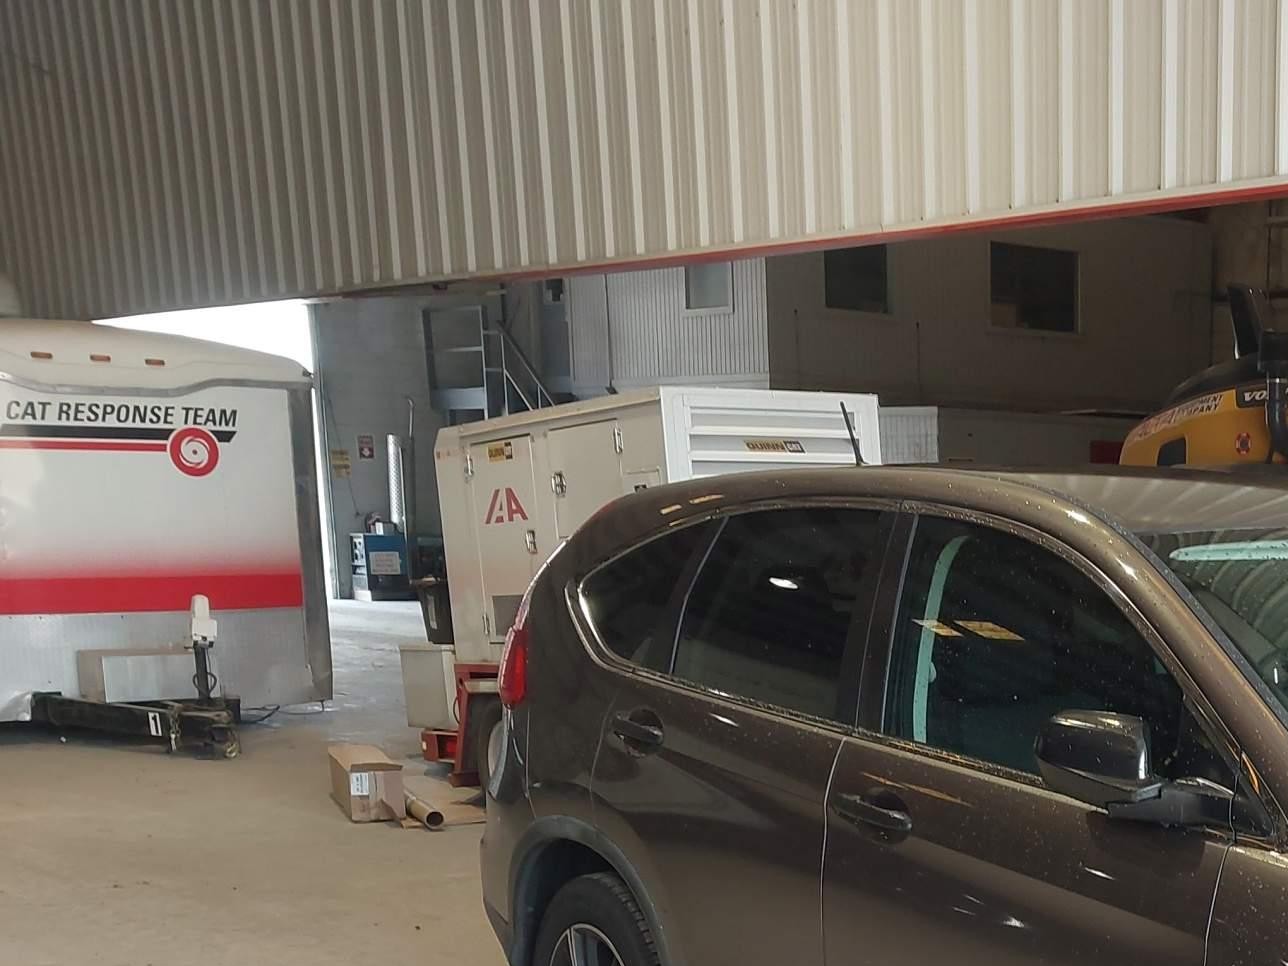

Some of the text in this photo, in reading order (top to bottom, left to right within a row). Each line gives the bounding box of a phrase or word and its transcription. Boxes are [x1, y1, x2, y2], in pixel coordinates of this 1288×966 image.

[6, 400, 238, 428] CAT RESPONSE TEAM
